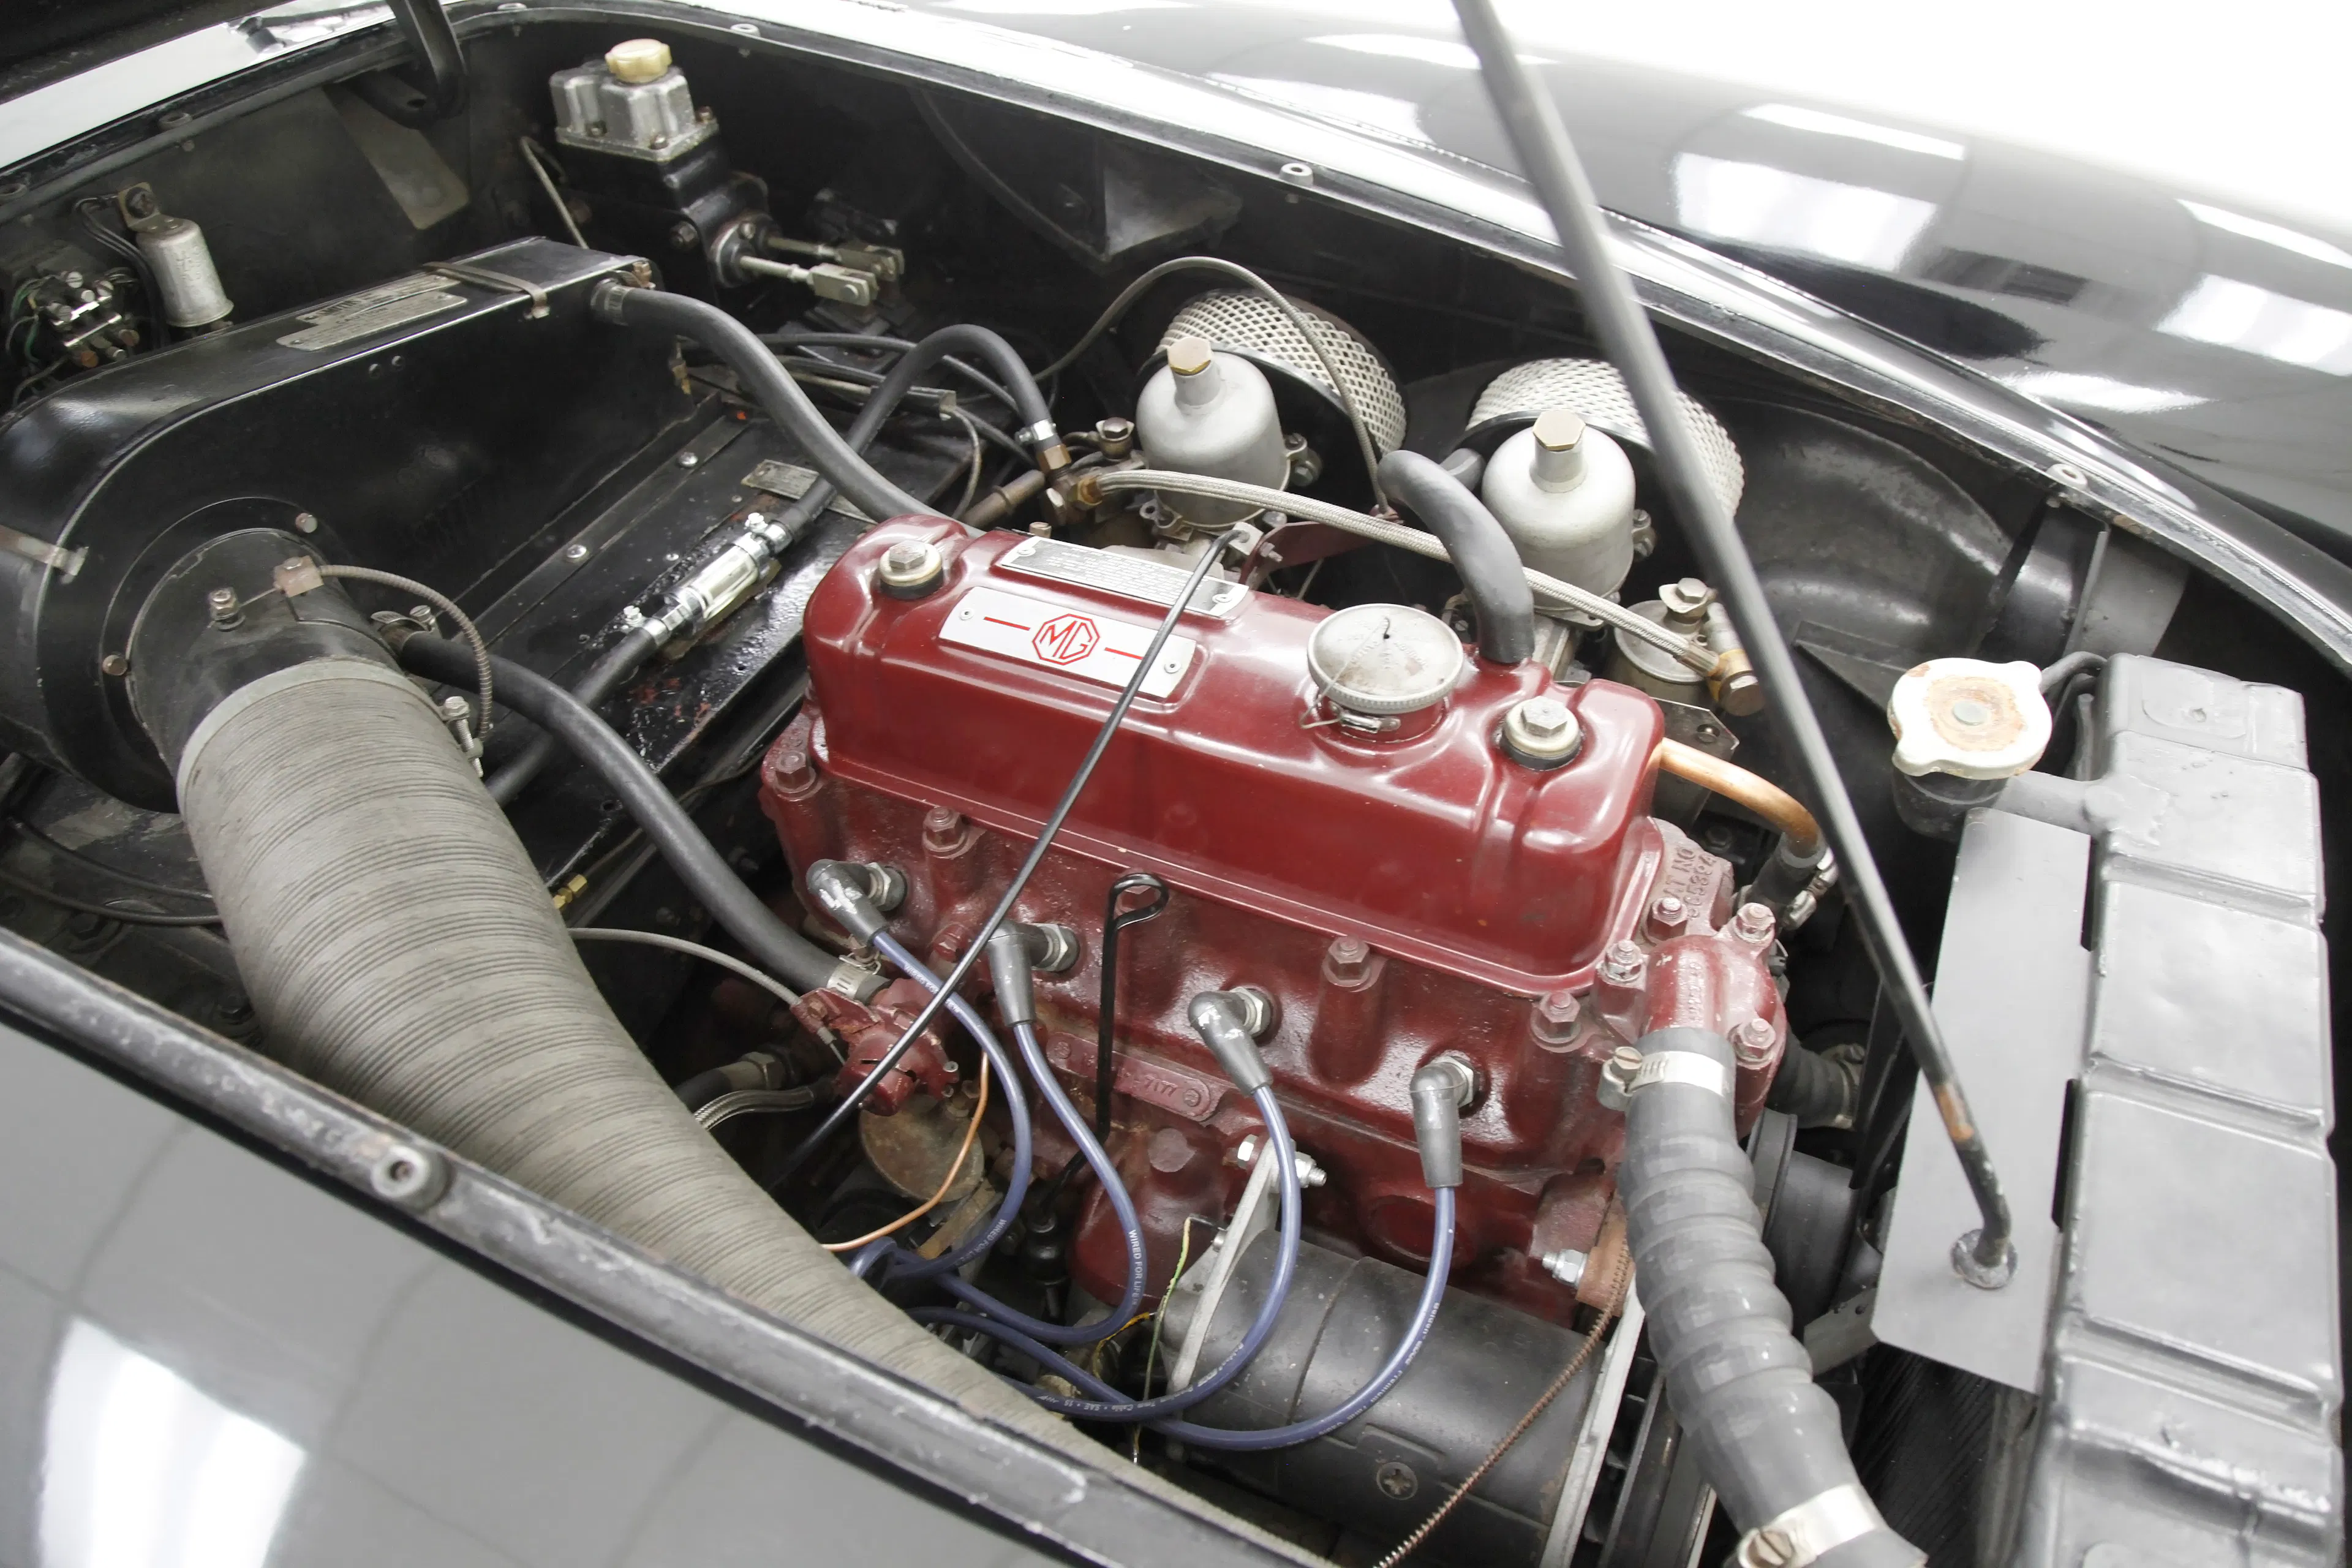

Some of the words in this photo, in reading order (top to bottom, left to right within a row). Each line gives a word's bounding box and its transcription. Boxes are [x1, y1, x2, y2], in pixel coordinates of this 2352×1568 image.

[1040, 620, 1091, 660] MG
[987, 1219, 1007, 1241] WIRED
[974, 1239, 989, 1253] FOR
[1128, 1229, 1141, 1259] WIRED
